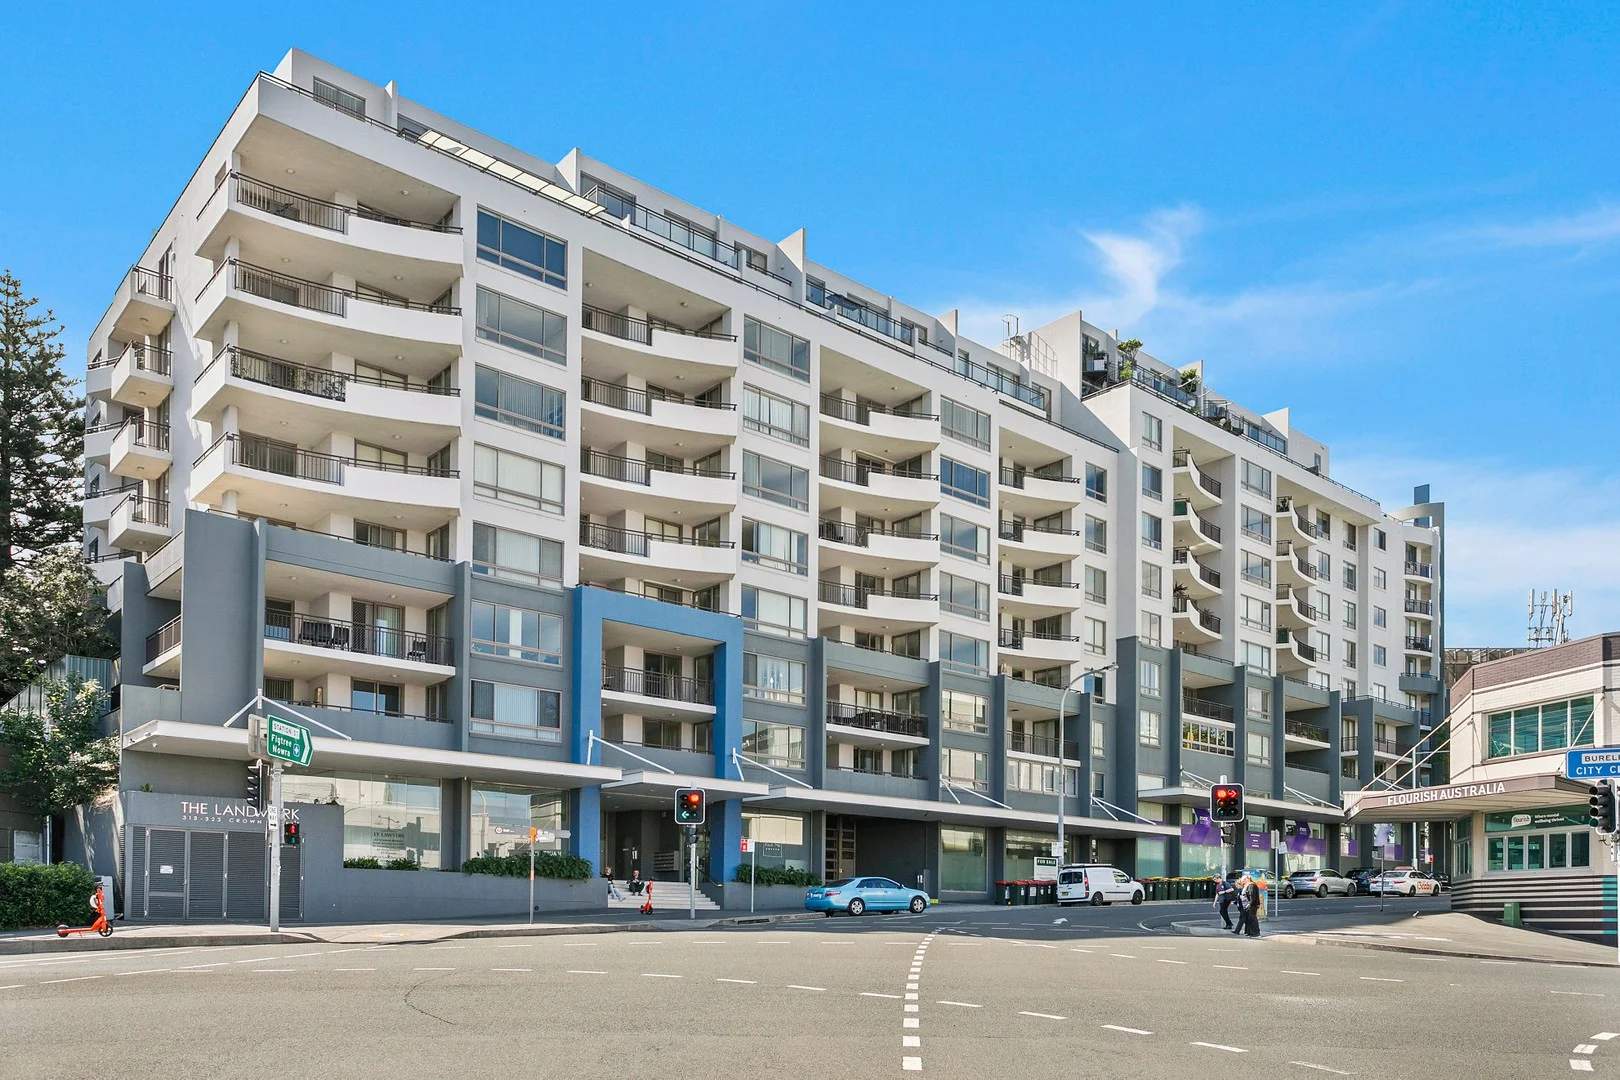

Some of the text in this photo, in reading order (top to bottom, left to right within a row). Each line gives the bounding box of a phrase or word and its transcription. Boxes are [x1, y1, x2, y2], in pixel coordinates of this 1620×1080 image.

[271, 733, 293, 748] Figtree
[272, 744, 291, 757] Nowra
[1575, 765, 1603, 776] CITY
[1387, 781, 1506, 806] FLOURISH AUSTRALIA
[181, 801, 208, 815] THE
[228, 817, 263, 825] CROWN
